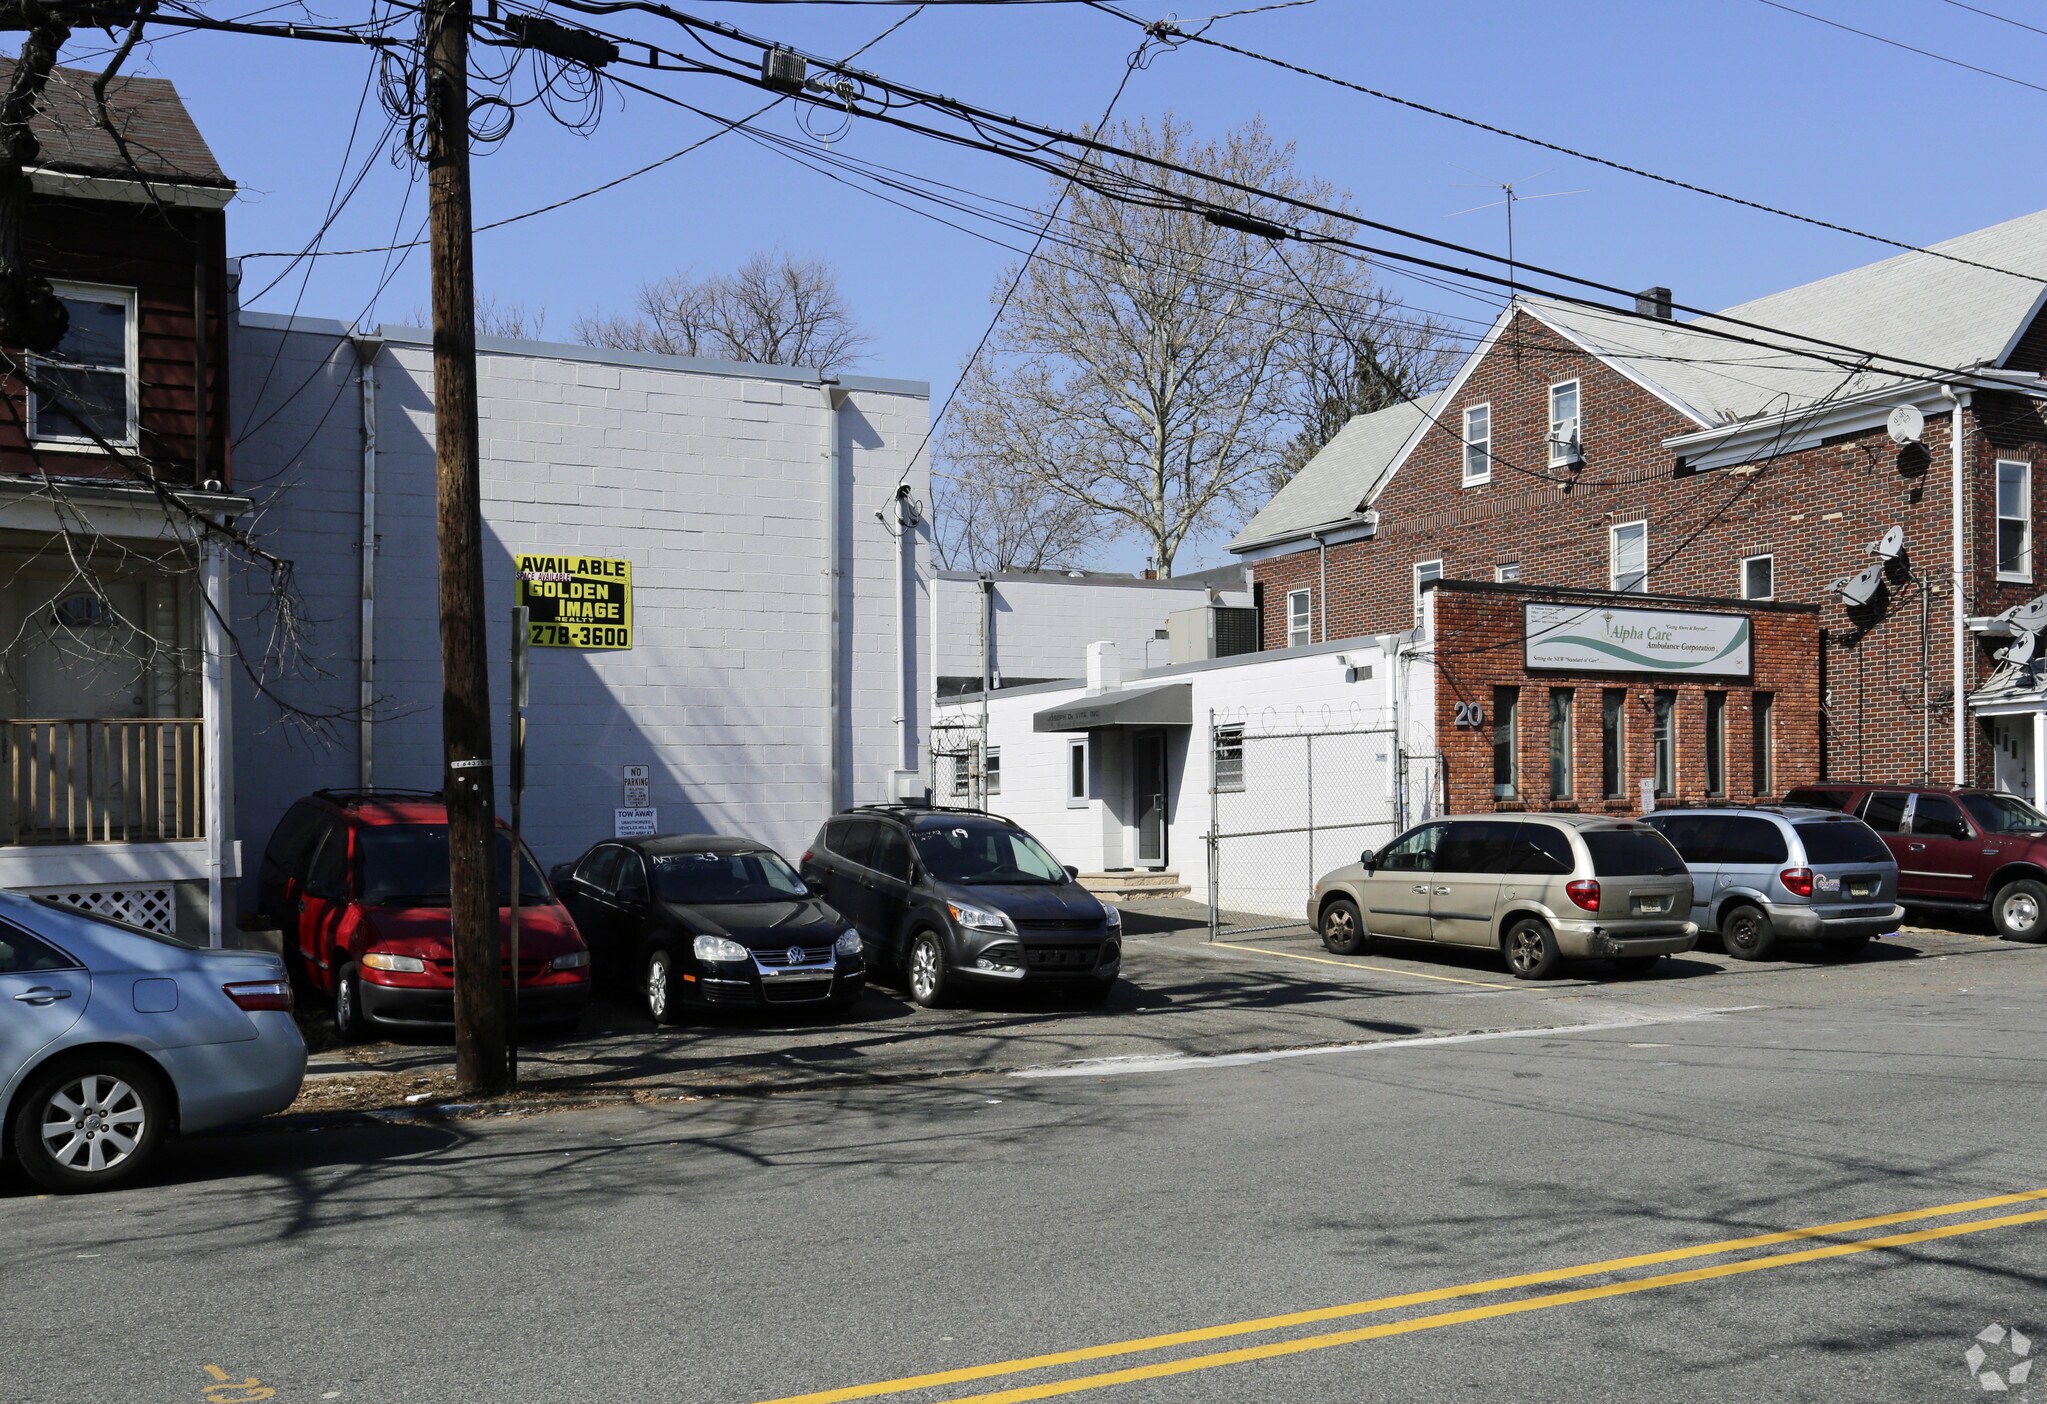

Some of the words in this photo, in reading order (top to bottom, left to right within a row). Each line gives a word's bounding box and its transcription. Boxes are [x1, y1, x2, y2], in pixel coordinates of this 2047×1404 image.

[520, 556, 626, 577] AVAILABLE
[515, 571, 535, 581] SPACE
[538, 572, 571, 582] AVAILABLE
[528, 580, 609, 600] GOLDEN
[559, 599, 620, 619] IMAGE
[531, 625, 628, 647] 278-3600
[1610, 625, 1643, 644] Alpha
[1647, 626, 1672, 641] Care
[1647, 641, 1680, 650] Ambulance
[1681, 642, 1715, 653] Corporation
[1453, 700, 1483, 727] 20
[624, 777, 649, 786] PARKING
[630, 767, 642, 777] NO
